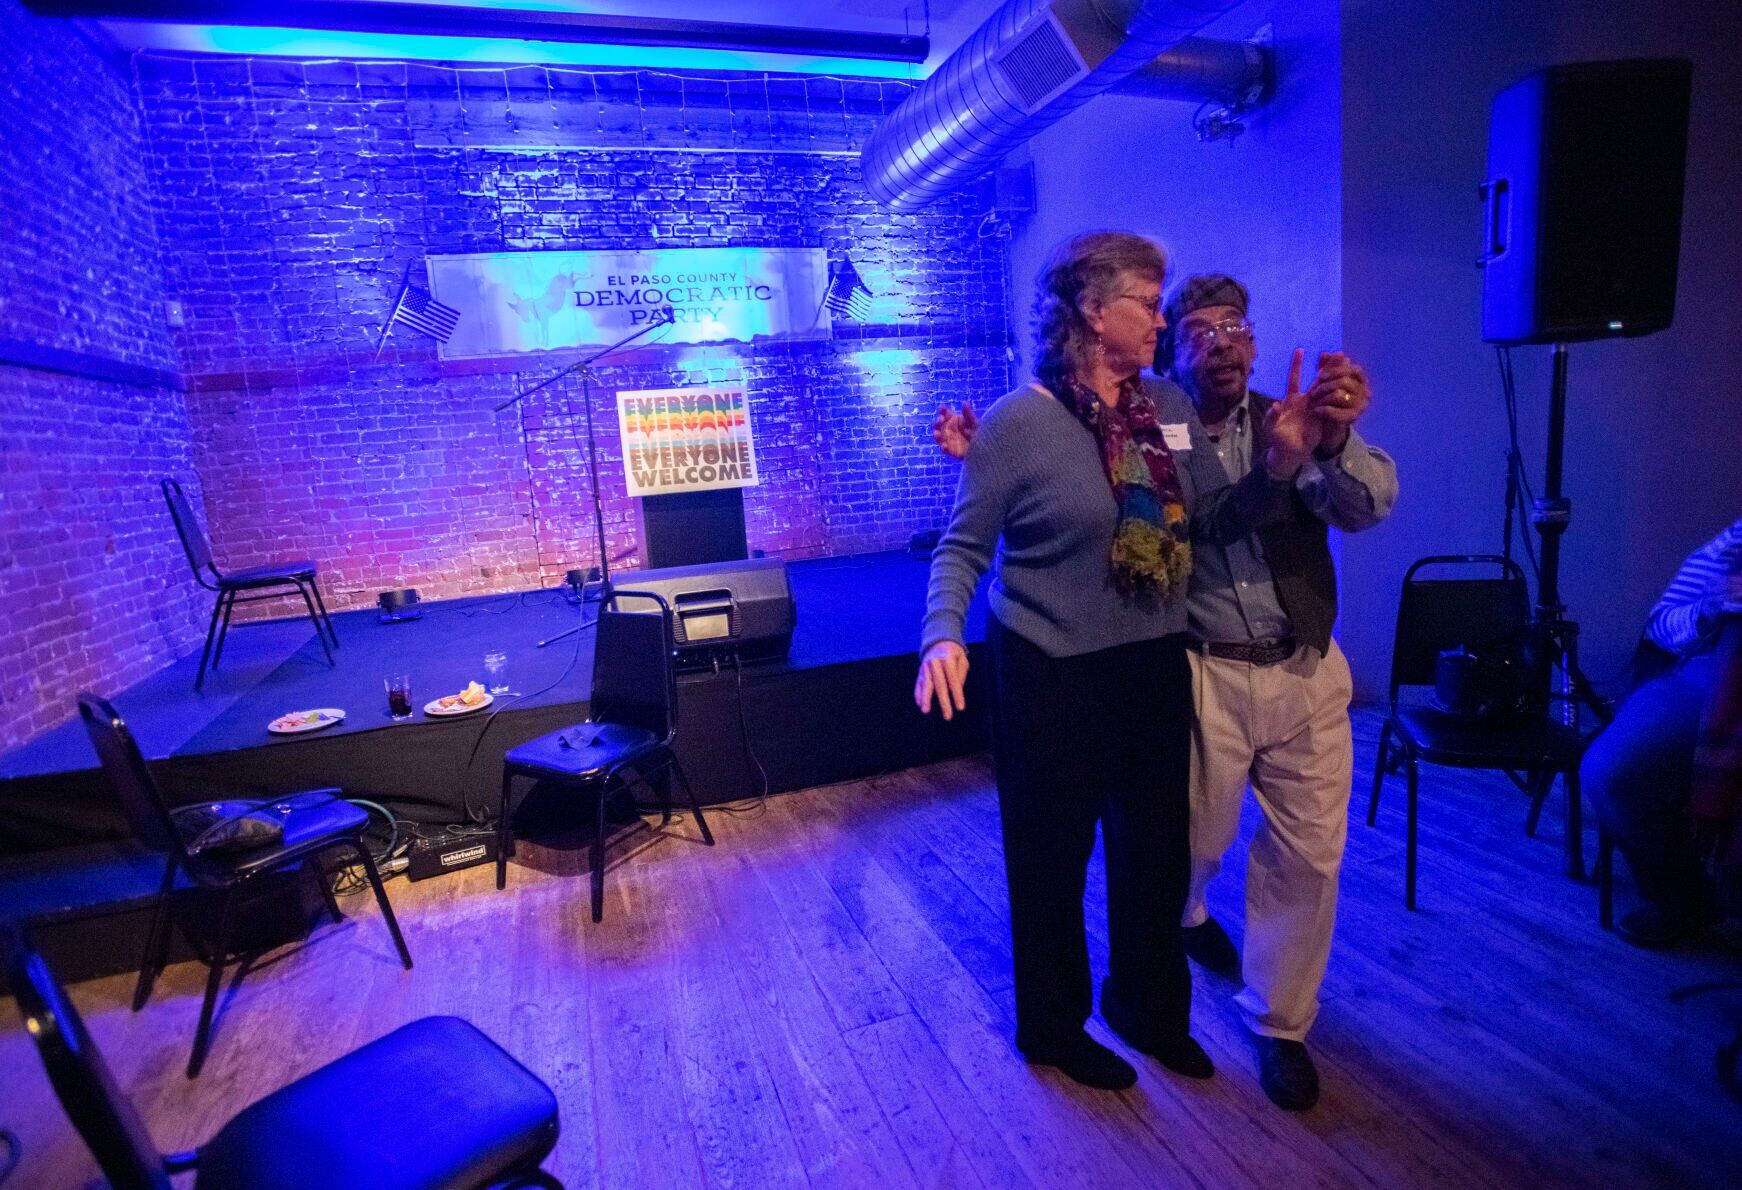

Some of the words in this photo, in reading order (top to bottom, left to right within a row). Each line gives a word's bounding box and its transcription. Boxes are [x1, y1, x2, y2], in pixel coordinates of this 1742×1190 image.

[607, 275, 626, 286] EL
[631, 273, 672, 286] PASO
[676, 272, 738, 284] COUNTY
[573, 285, 772, 307] DEMOCRATIC
[624, 392, 744, 419] EVERYONE
[629, 441, 750, 471] EVERYONE
[632, 462, 753, 488] WELCOME
[443, 847, 484, 862] whirlwind
